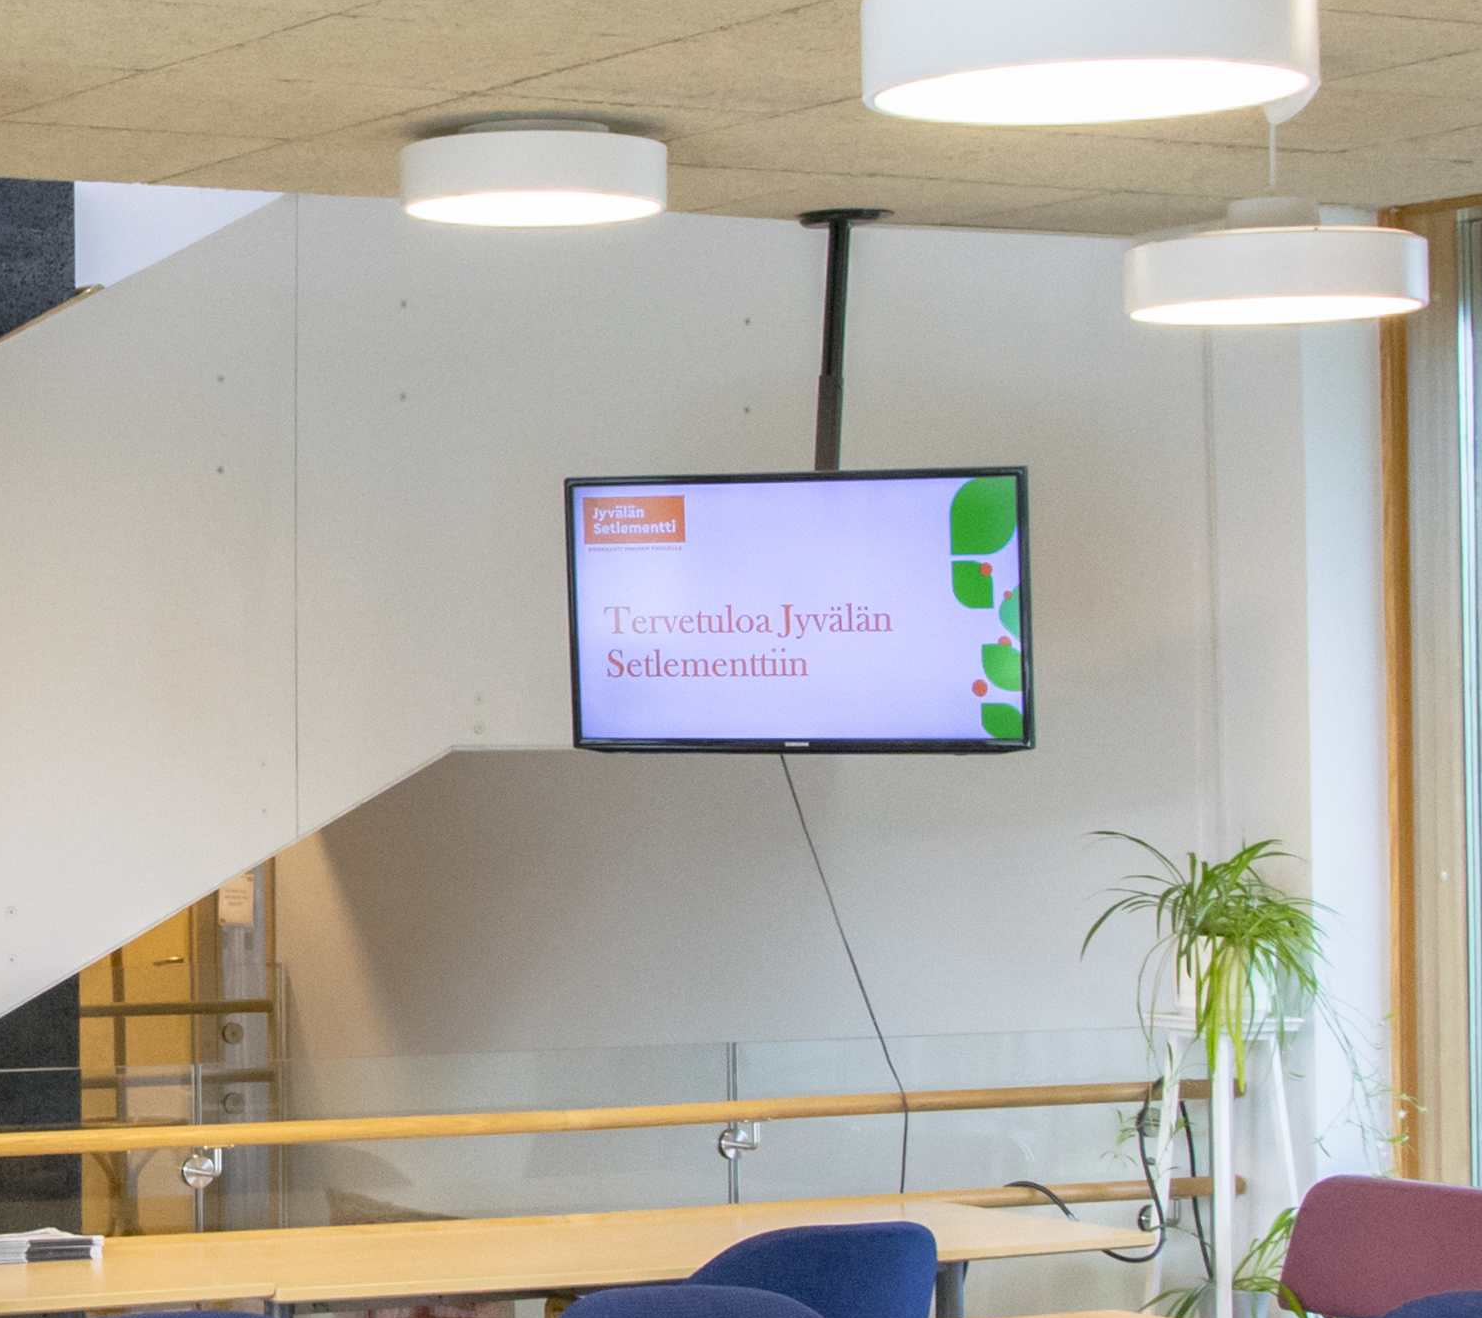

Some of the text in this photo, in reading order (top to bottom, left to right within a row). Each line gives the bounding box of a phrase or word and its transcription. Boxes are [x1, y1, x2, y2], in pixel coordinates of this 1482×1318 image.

[592, 505, 645, 521] Jyvälän
[593, 519, 676, 535] Setlementti
[604, 603, 893, 639] Tervetuloa Jyvälän
[606, 647, 808, 679] Setlementtiin
